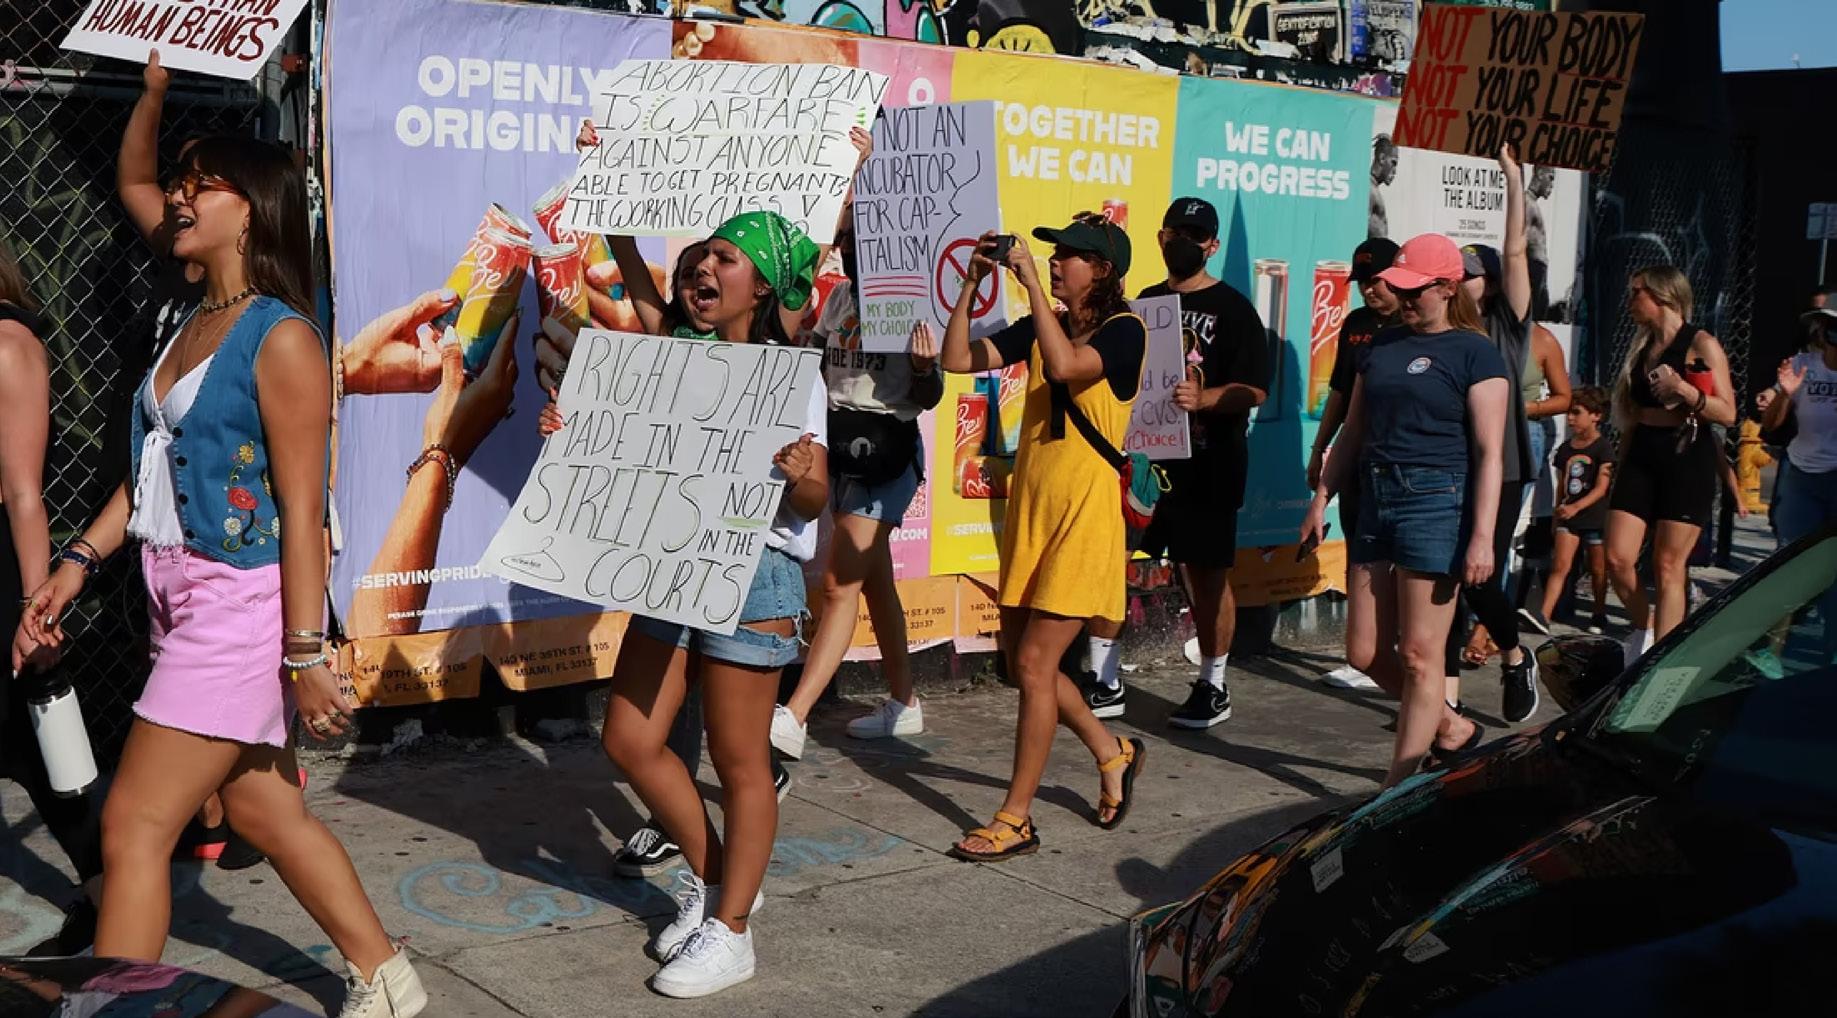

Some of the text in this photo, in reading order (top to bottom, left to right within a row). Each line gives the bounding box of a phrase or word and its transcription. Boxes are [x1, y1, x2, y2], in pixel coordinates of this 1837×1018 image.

[82, 0, 279, 61] HUMAN BEINGS
[1415, 6, 1486, 62] NOT
[1487, 11, 1557, 66] YOUR
[1557, 13, 1644, 79] BODY
[610, 61, 889, 104] ABORTION BAN
[1401, 60, 1624, 128] NOT YOUR LIFE
[395, 105, 588, 154] ORIGIN
[594, 93, 854, 136] IS WARFARE
[933, 105, 966, 148] AN
[578, 134, 846, 170] AGAINST ANYONE
[1225, 121, 1332, 162] WE CAN
[1391, 107, 1618, 173] NOT YOUR CHOICE
[570, 174, 632, 196] ABLE
[1008, 144, 1133, 186] WE CAN
[1196, 157, 1350, 200] PROGRESS
[1442, 165, 1504, 189] LOOK AT ME
[567, 195, 609, 226] THE
[608, 195, 704, 230] WORKING
[855, 195, 942, 235] FOR CAP-
[1444, 188, 1503, 211] THE ALBUM
[860, 320, 878, 337] MY
[866, 300, 916, 318] MY BODY
[577, 336, 823, 430] RIGHTS ARE
[541, 409, 756, 475] MADE IN THE
[523, 462, 783, 553] STREETS NOT
[698, 529, 758, 556] IN THE
[352, 565, 492, 590] #SERVINGPRID
[585, 548, 746, 625] COURTS
